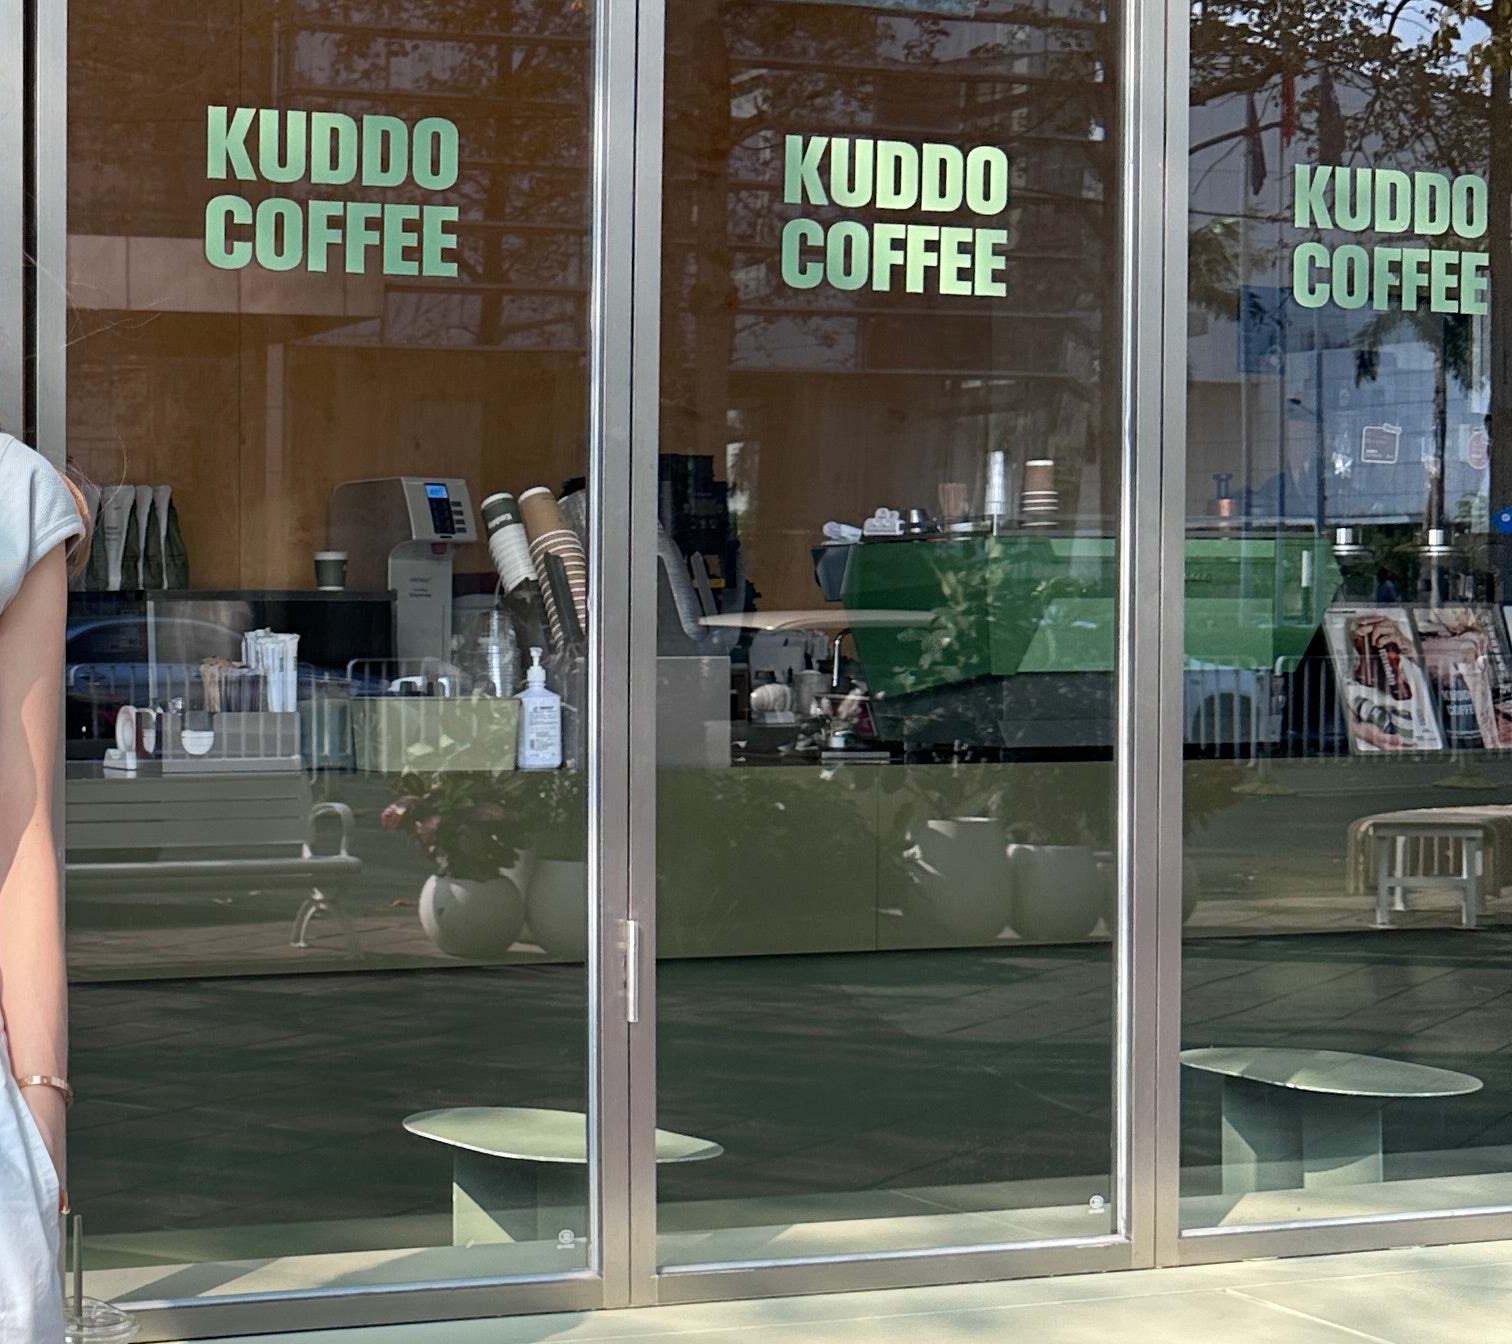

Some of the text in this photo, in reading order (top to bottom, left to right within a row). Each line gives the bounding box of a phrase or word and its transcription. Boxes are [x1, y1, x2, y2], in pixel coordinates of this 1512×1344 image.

[206, 104, 460, 192] KUDDO
[783, 135, 1009, 216] KUDDO
[204, 194, 460, 278] COFFEE
[1294, 163, 1489, 240] KUDDO
[781, 217, 1008, 298] COFFEE
[1292, 241, 1490, 316] COFFEE
